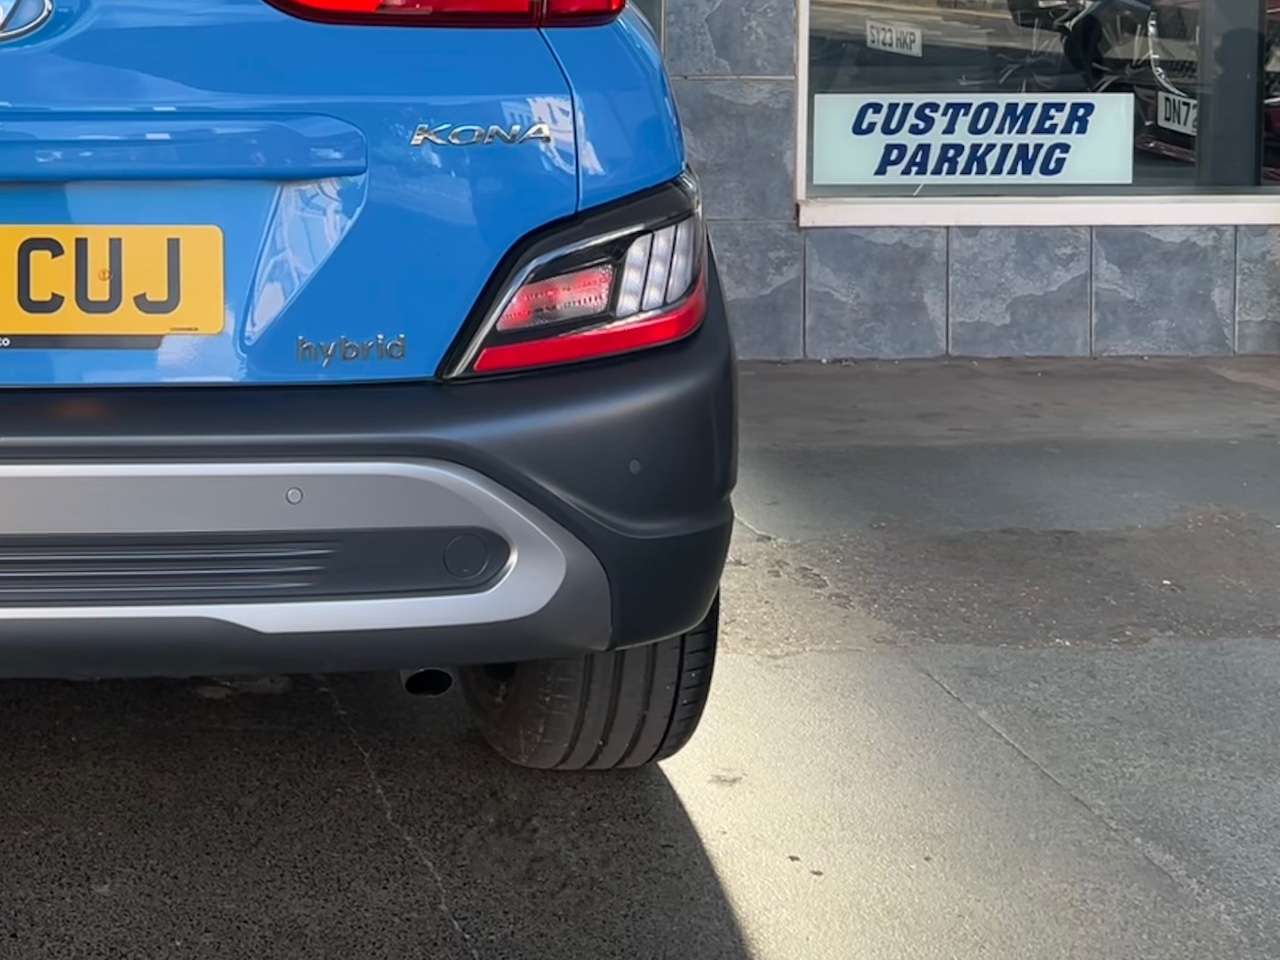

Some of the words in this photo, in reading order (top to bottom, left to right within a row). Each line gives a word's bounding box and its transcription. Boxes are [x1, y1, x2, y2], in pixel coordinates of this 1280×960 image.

[410, 123, 552, 145] KONA
[851, 102, 1095, 136] CUSTOMER
[873, 142, 1072, 176] PARKING
[17, 237, 181, 315] CUJ
[297, 333, 406, 368] hybrid
